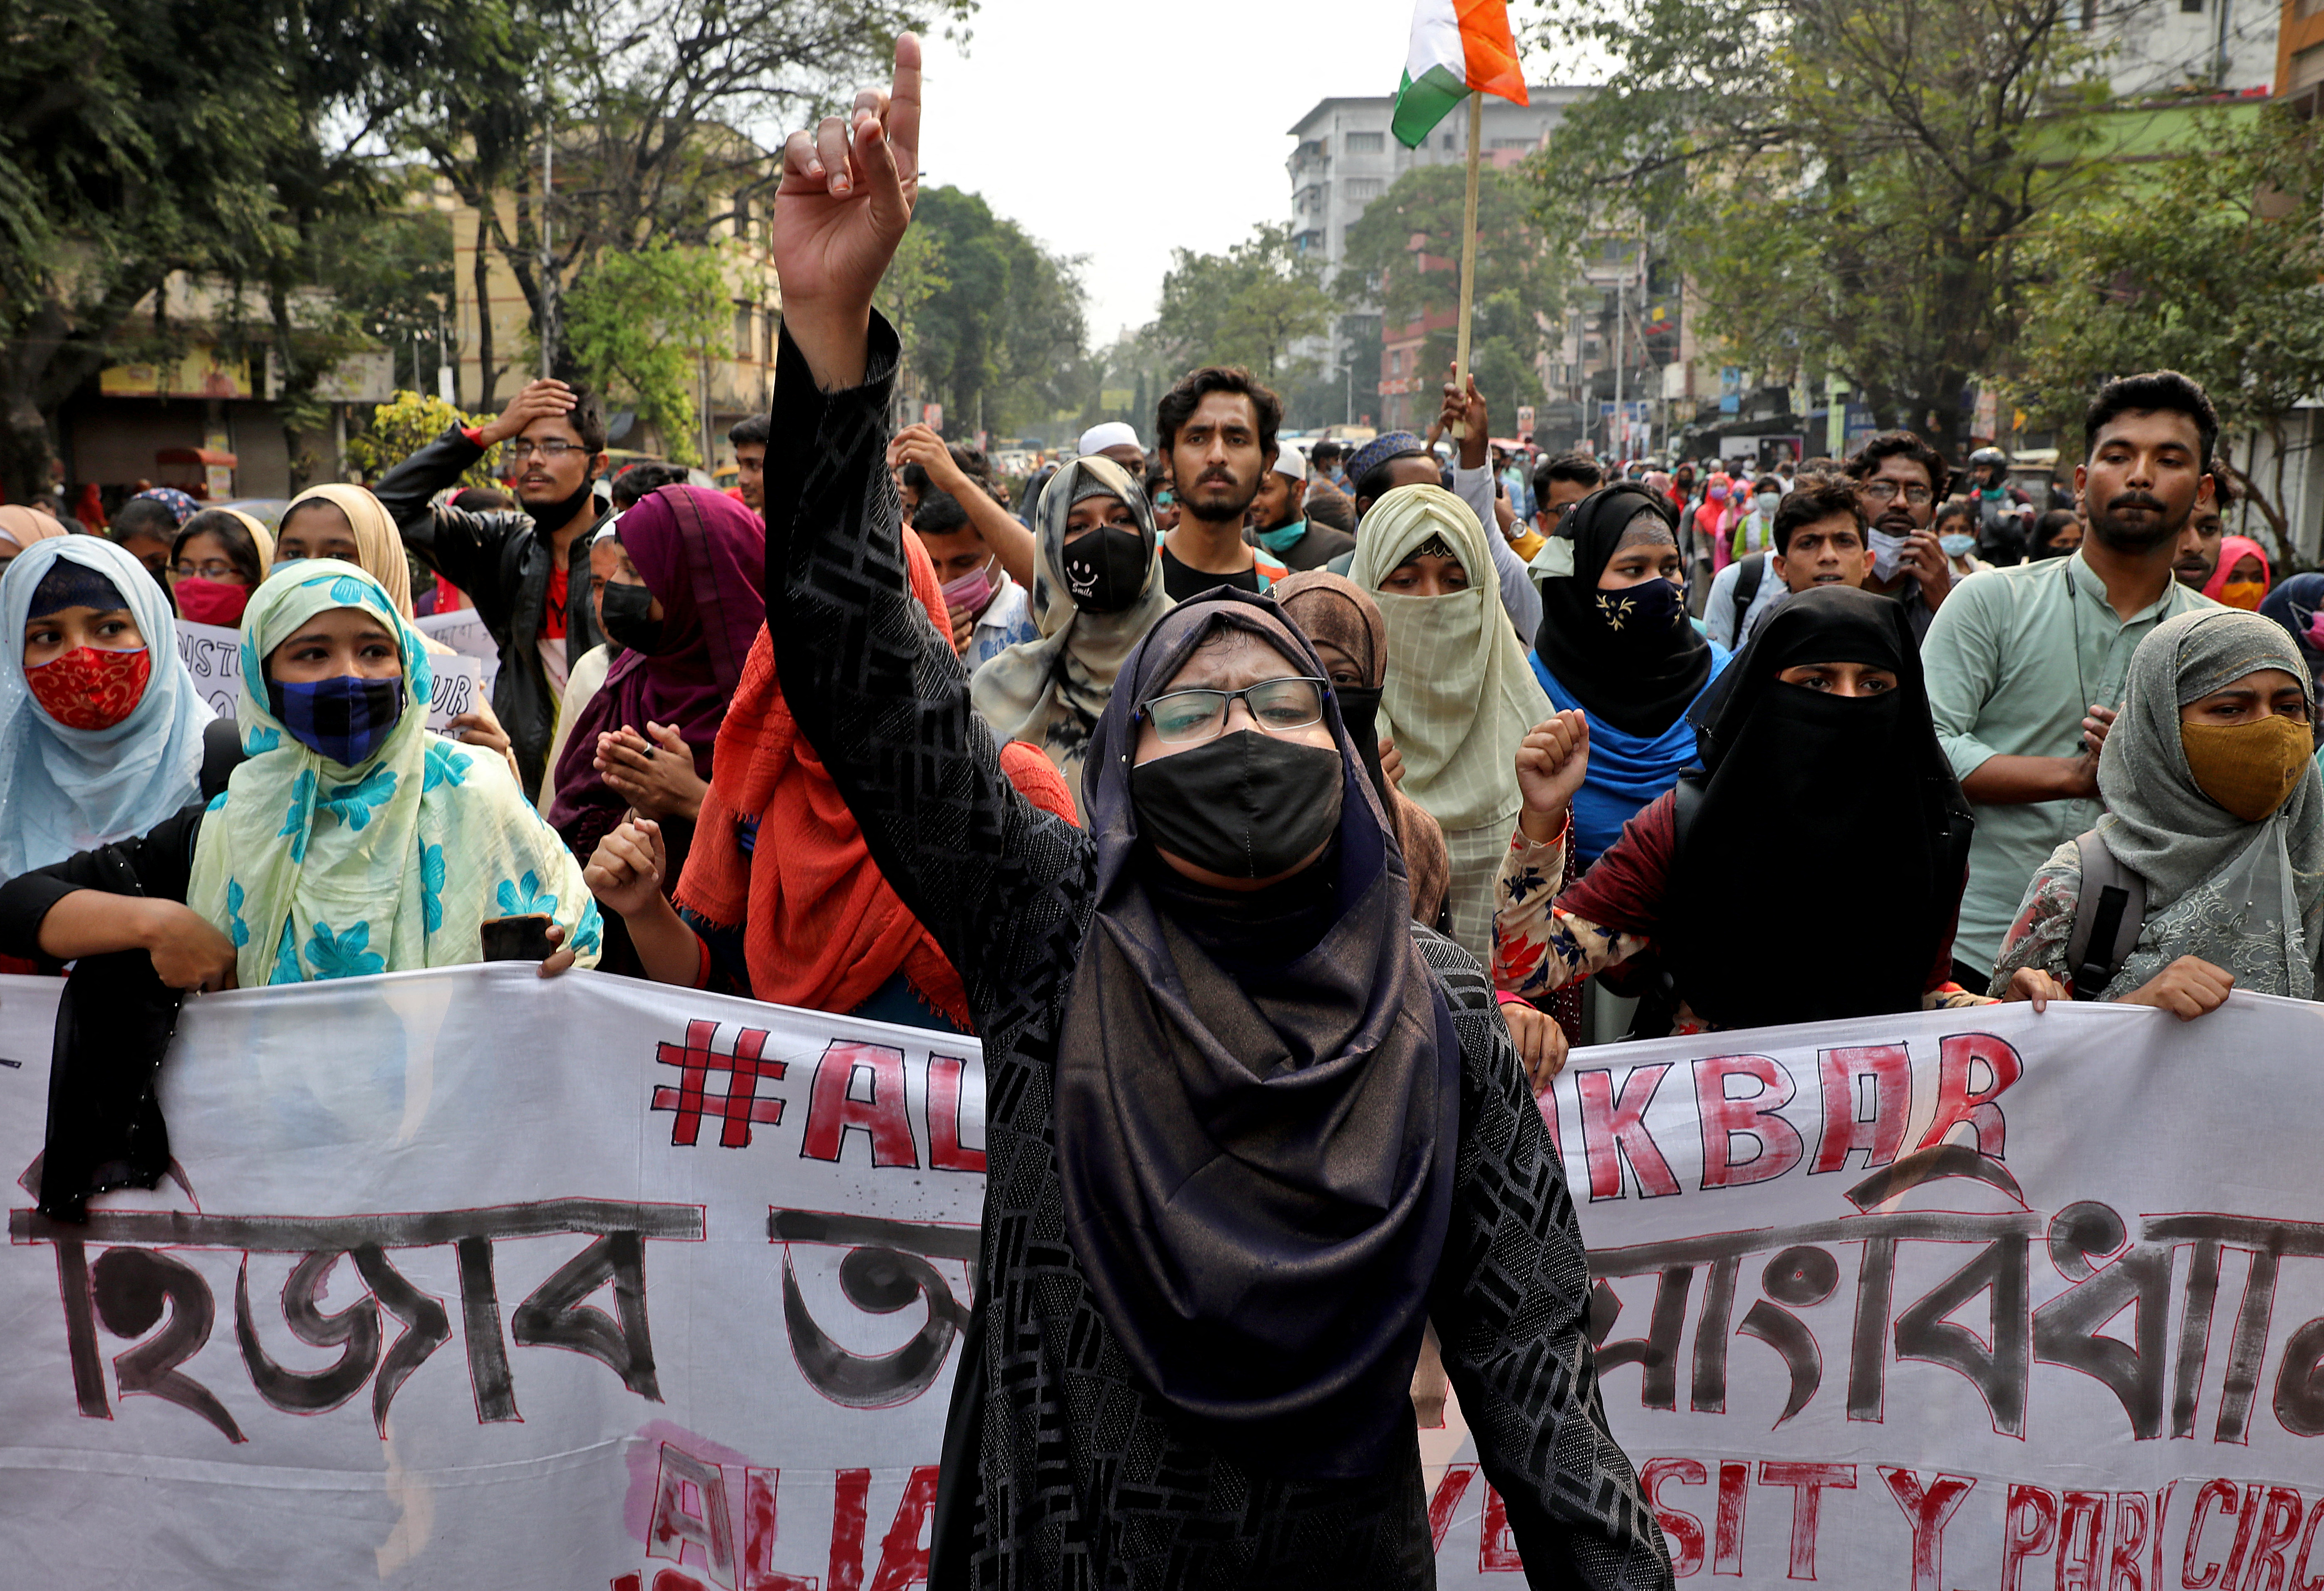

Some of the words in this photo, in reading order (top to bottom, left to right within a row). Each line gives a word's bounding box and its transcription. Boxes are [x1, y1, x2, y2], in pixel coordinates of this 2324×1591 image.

[1072, 582, 1093, 598] Smile
[177, 631, 240, 677] NST
[431, 675, 471, 716] UR
[650, 1018, 987, 1173] #AL
